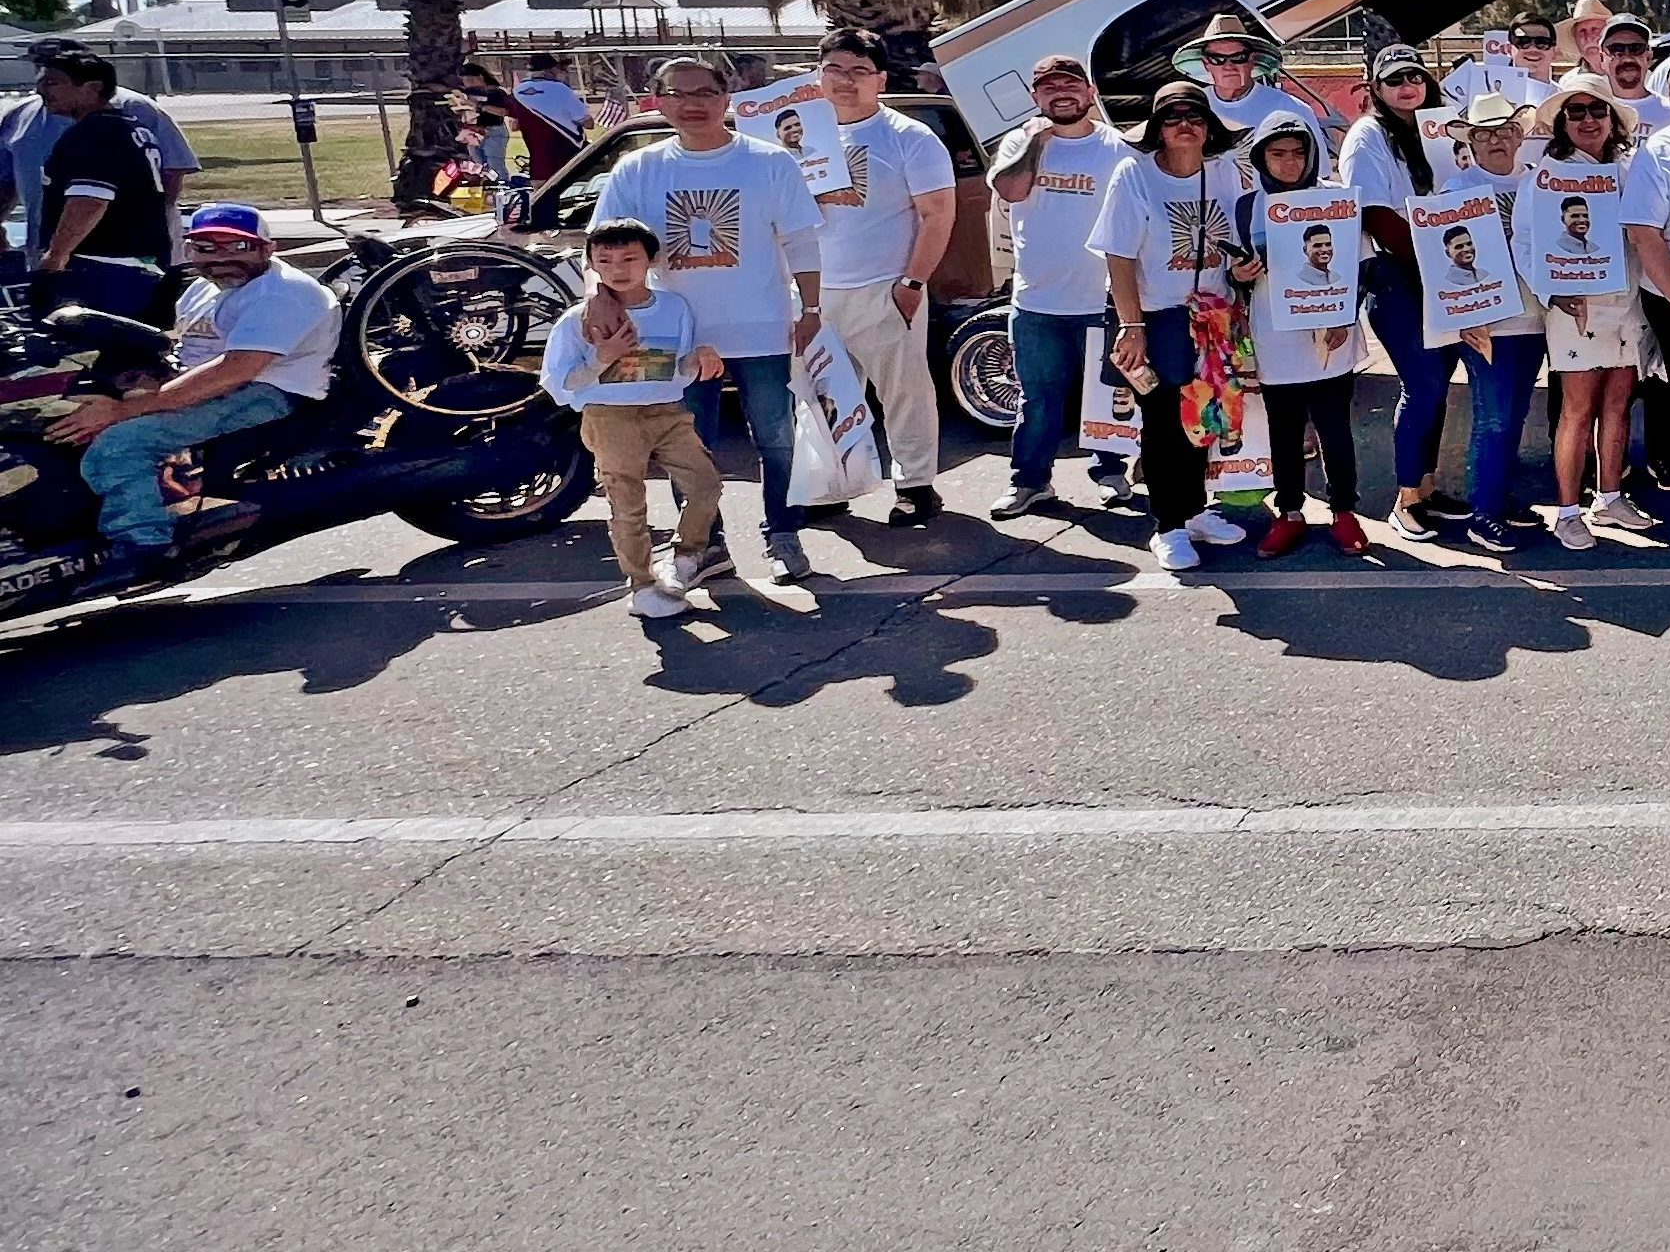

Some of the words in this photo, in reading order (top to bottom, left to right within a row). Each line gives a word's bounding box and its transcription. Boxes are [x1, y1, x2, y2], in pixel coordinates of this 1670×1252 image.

[1036, 173, 1096, 192] ondit
[1536, 169, 1618, 194] Condit
[1267, 199, 1357, 224] Condit
[1412, 196, 1497, 228] Condit
[1083, 420, 1138, 440] ondit
